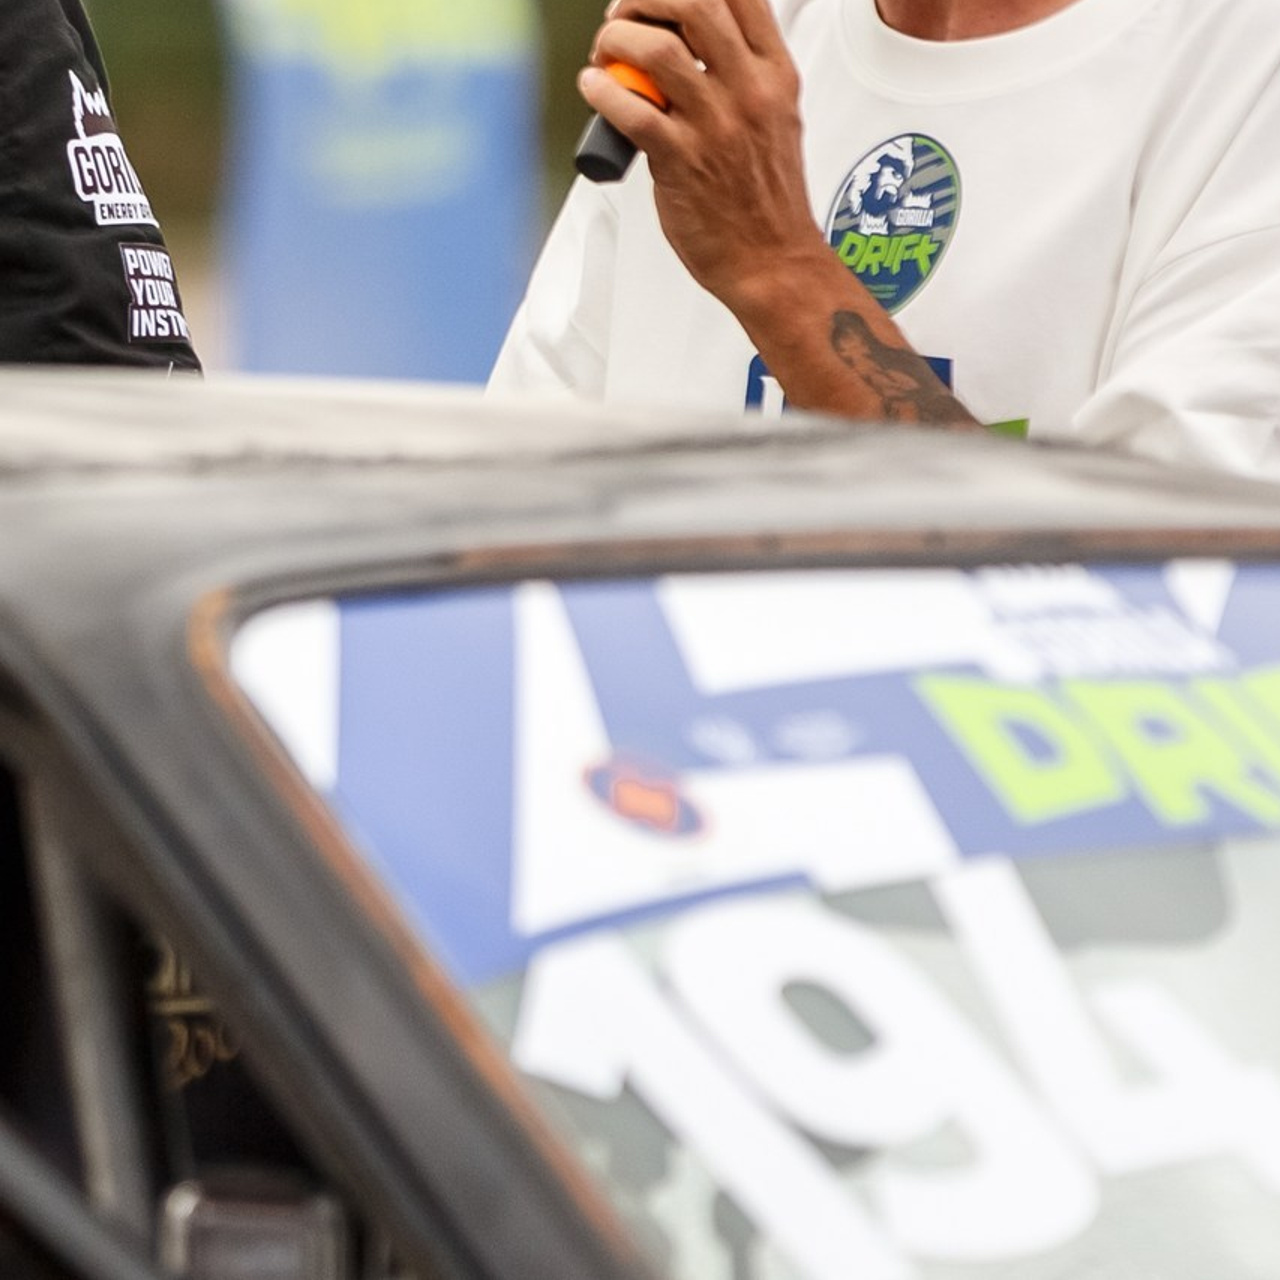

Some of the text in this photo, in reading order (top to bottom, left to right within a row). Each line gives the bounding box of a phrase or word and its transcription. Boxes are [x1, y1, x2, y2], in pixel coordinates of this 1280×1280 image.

[100, 203, 137, 220] ENERGY
[894, 208, 933, 227] GORILLA
[838, 231, 939, 277] DRIFT
